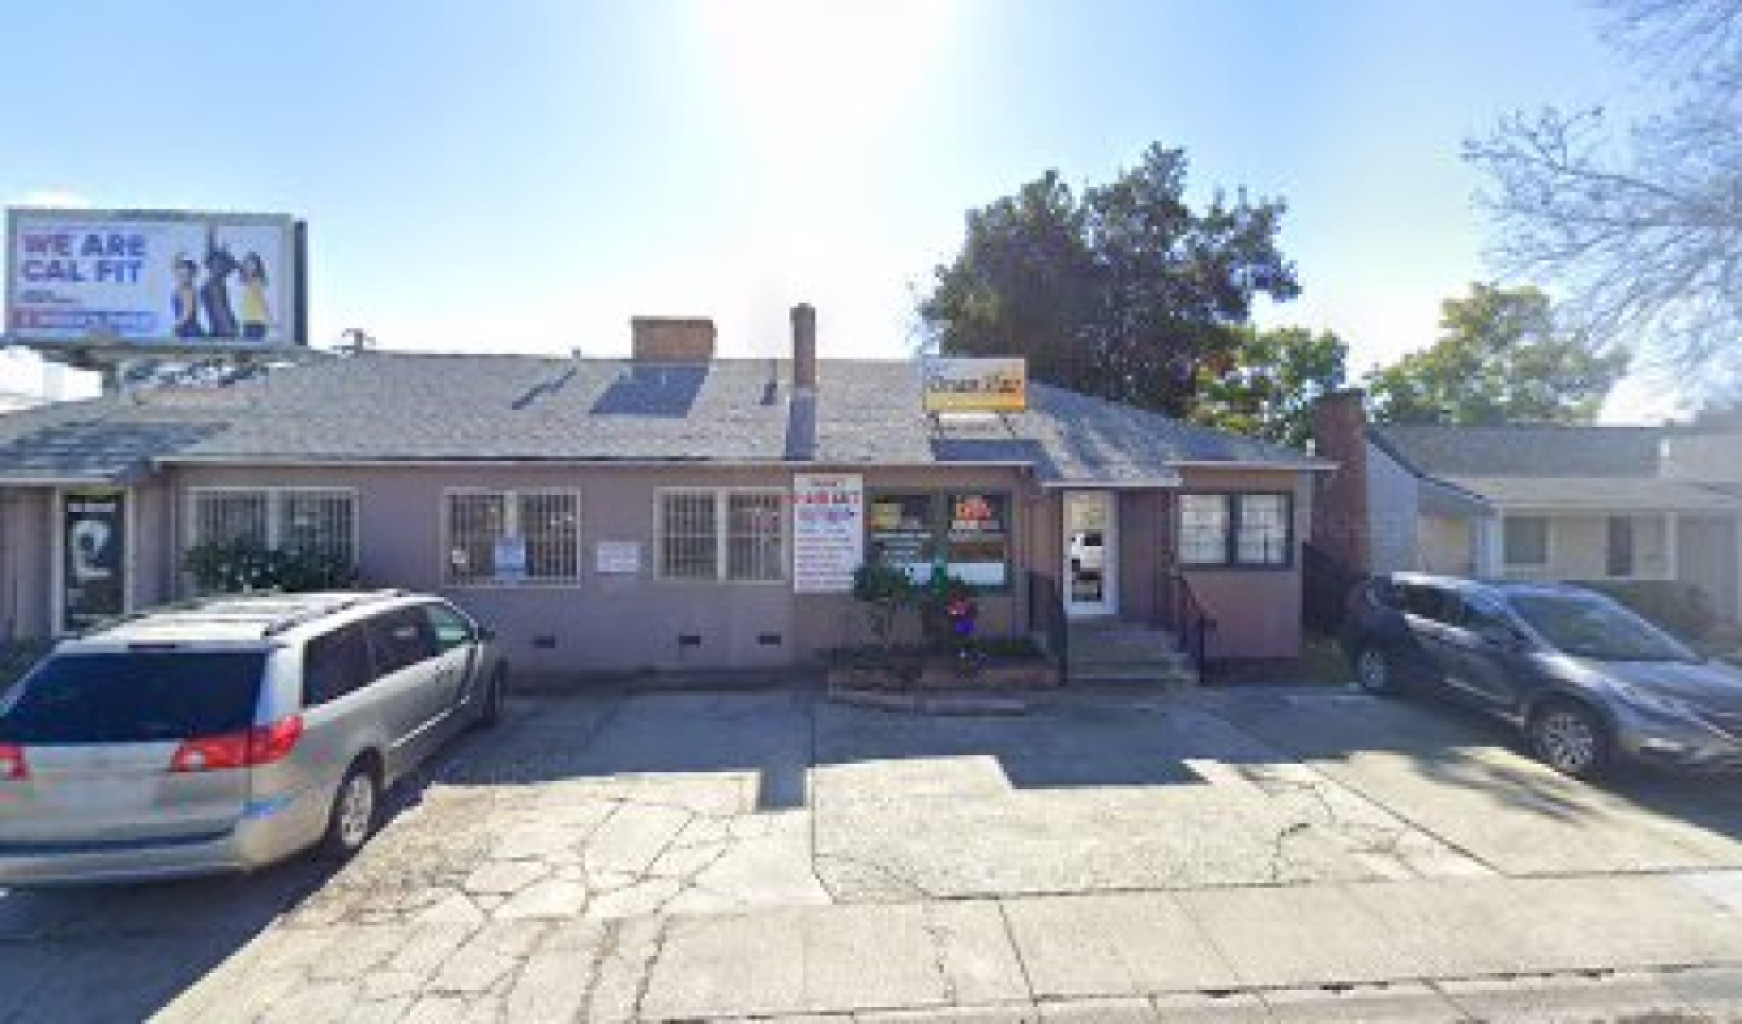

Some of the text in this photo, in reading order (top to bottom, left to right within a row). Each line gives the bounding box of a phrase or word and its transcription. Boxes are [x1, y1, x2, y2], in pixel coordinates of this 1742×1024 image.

[22, 234, 146, 256] WE ARE
[22, 259, 142, 282] CAL FIT
